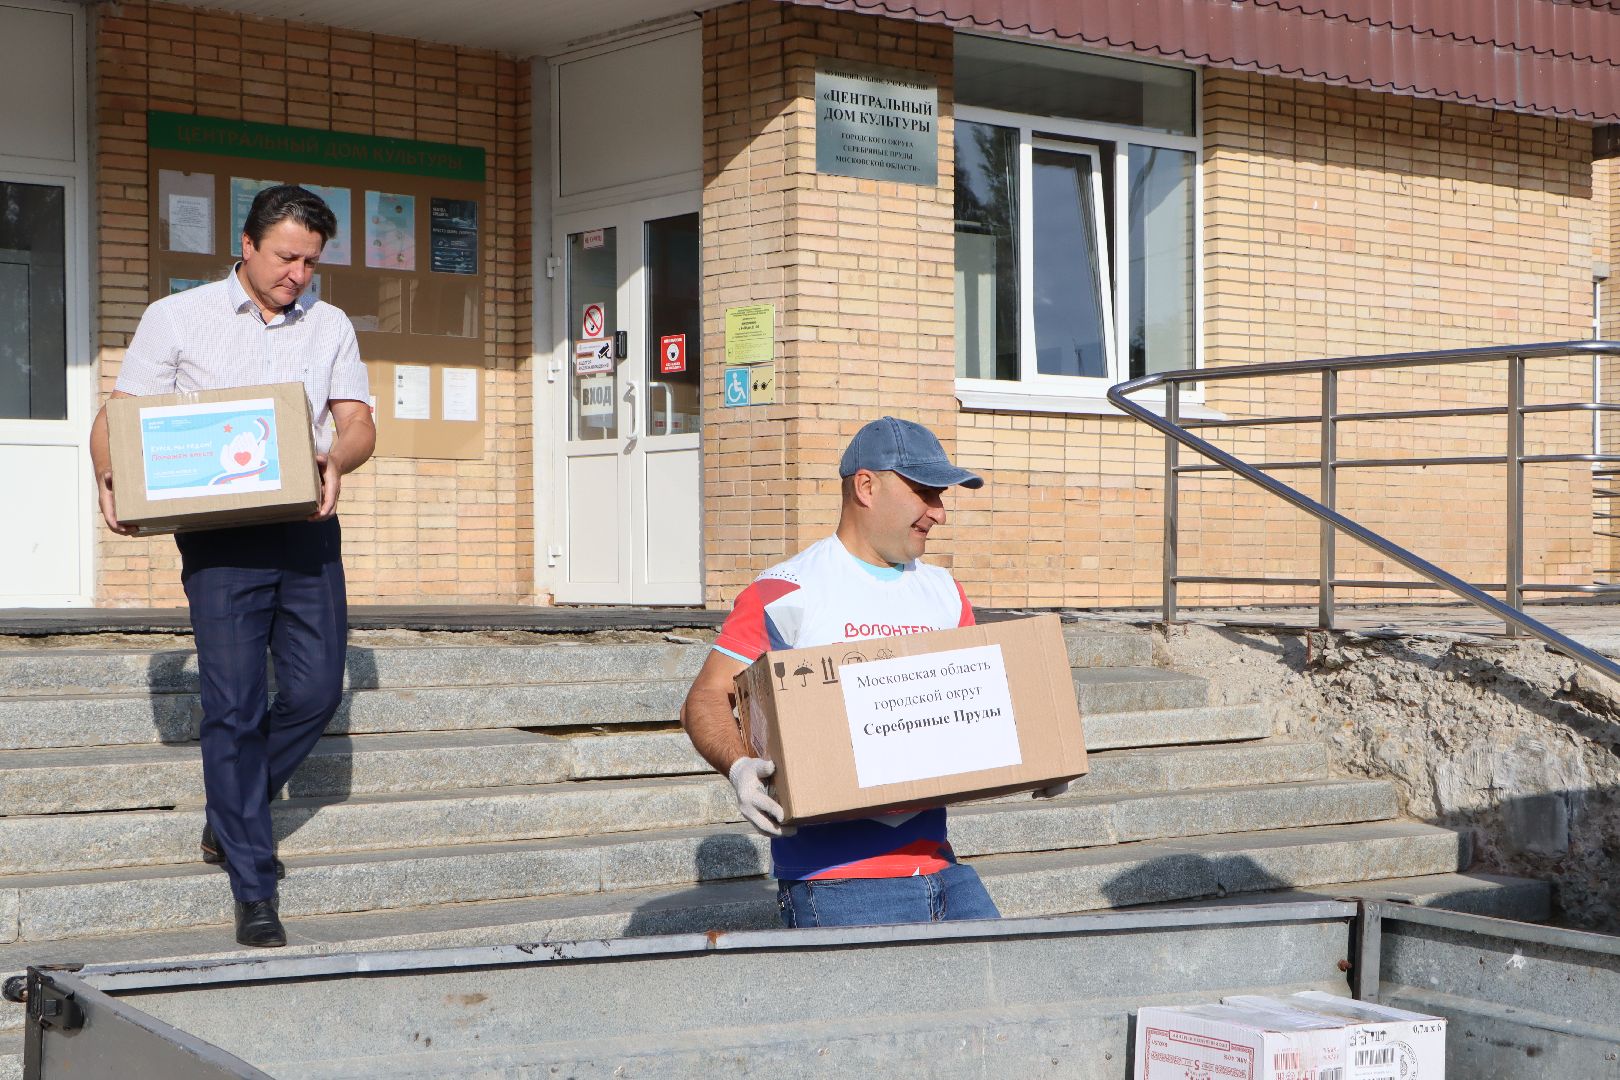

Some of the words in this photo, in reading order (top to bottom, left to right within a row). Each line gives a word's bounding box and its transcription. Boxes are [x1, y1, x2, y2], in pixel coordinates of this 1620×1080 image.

[823, 89, 932, 116] «ЦЕНТРАЛЬНЫЙ
[823, 107, 855, 122] ДОМ
[860, 112, 930, 132] КУЛЬТУРЫ
[178, 126, 321, 154] ЦЕНТРАЛЬНЫЙ
[325, 146, 368, 160] ДОМ
[374, 149, 463, 170] КУЛЬТУРЫ
[841, 132, 887, 145] ГОРОДСКОГО
[888, 138, 914, 149] ОКРУГА
[843, 145, 889, 157] СЕРЕБРЯНЫЕ
[890, 150, 913, 160] ПРУДЫ
[836, 155, 885, 168] МОСКОВСКОЙ
[583, 386, 612, 406] ВХОД
[844, 622, 941, 639] ВОЛОНТЕР
[856, 668, 937, 688] Московская
[940, 661, 991, 677] область
[874, 690, 942, 711] городской
[946, 686, 983, 700] округ
[863, 713, 950, 737] Серебряные
[953, 707, 1001, 724] Пруды
